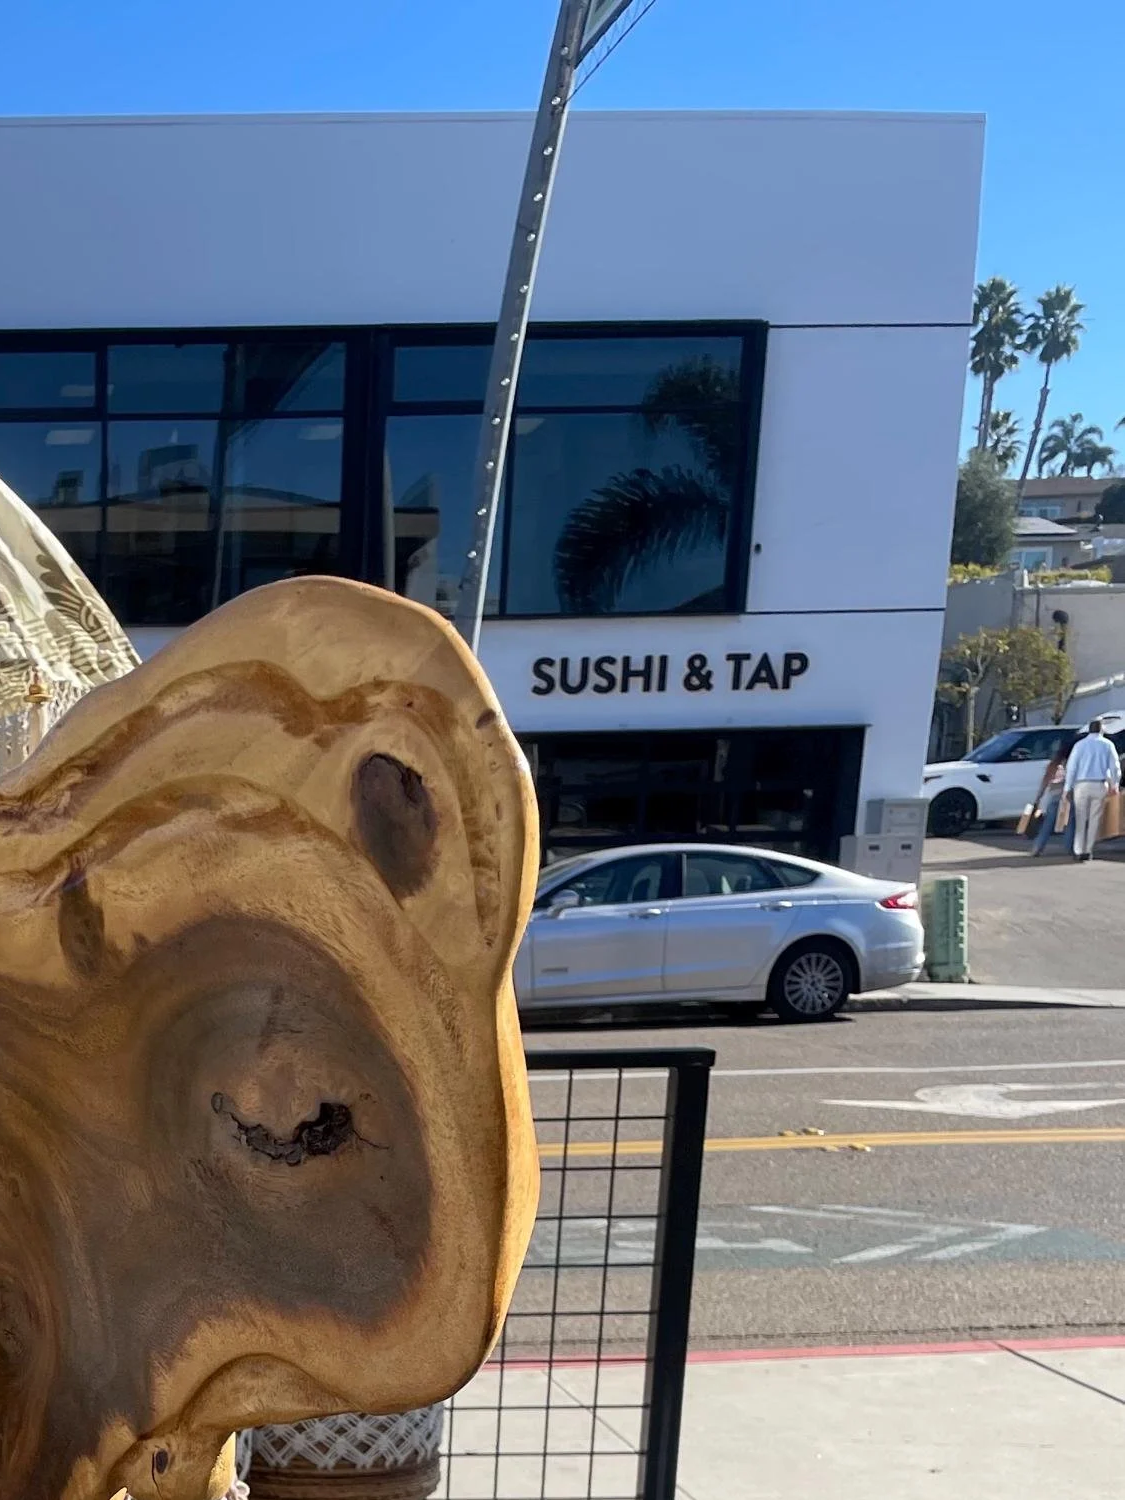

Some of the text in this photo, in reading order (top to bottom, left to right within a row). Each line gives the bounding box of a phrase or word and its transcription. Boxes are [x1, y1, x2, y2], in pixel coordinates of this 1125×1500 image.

[531, 651, 810, 696] SUSHI & TAP
